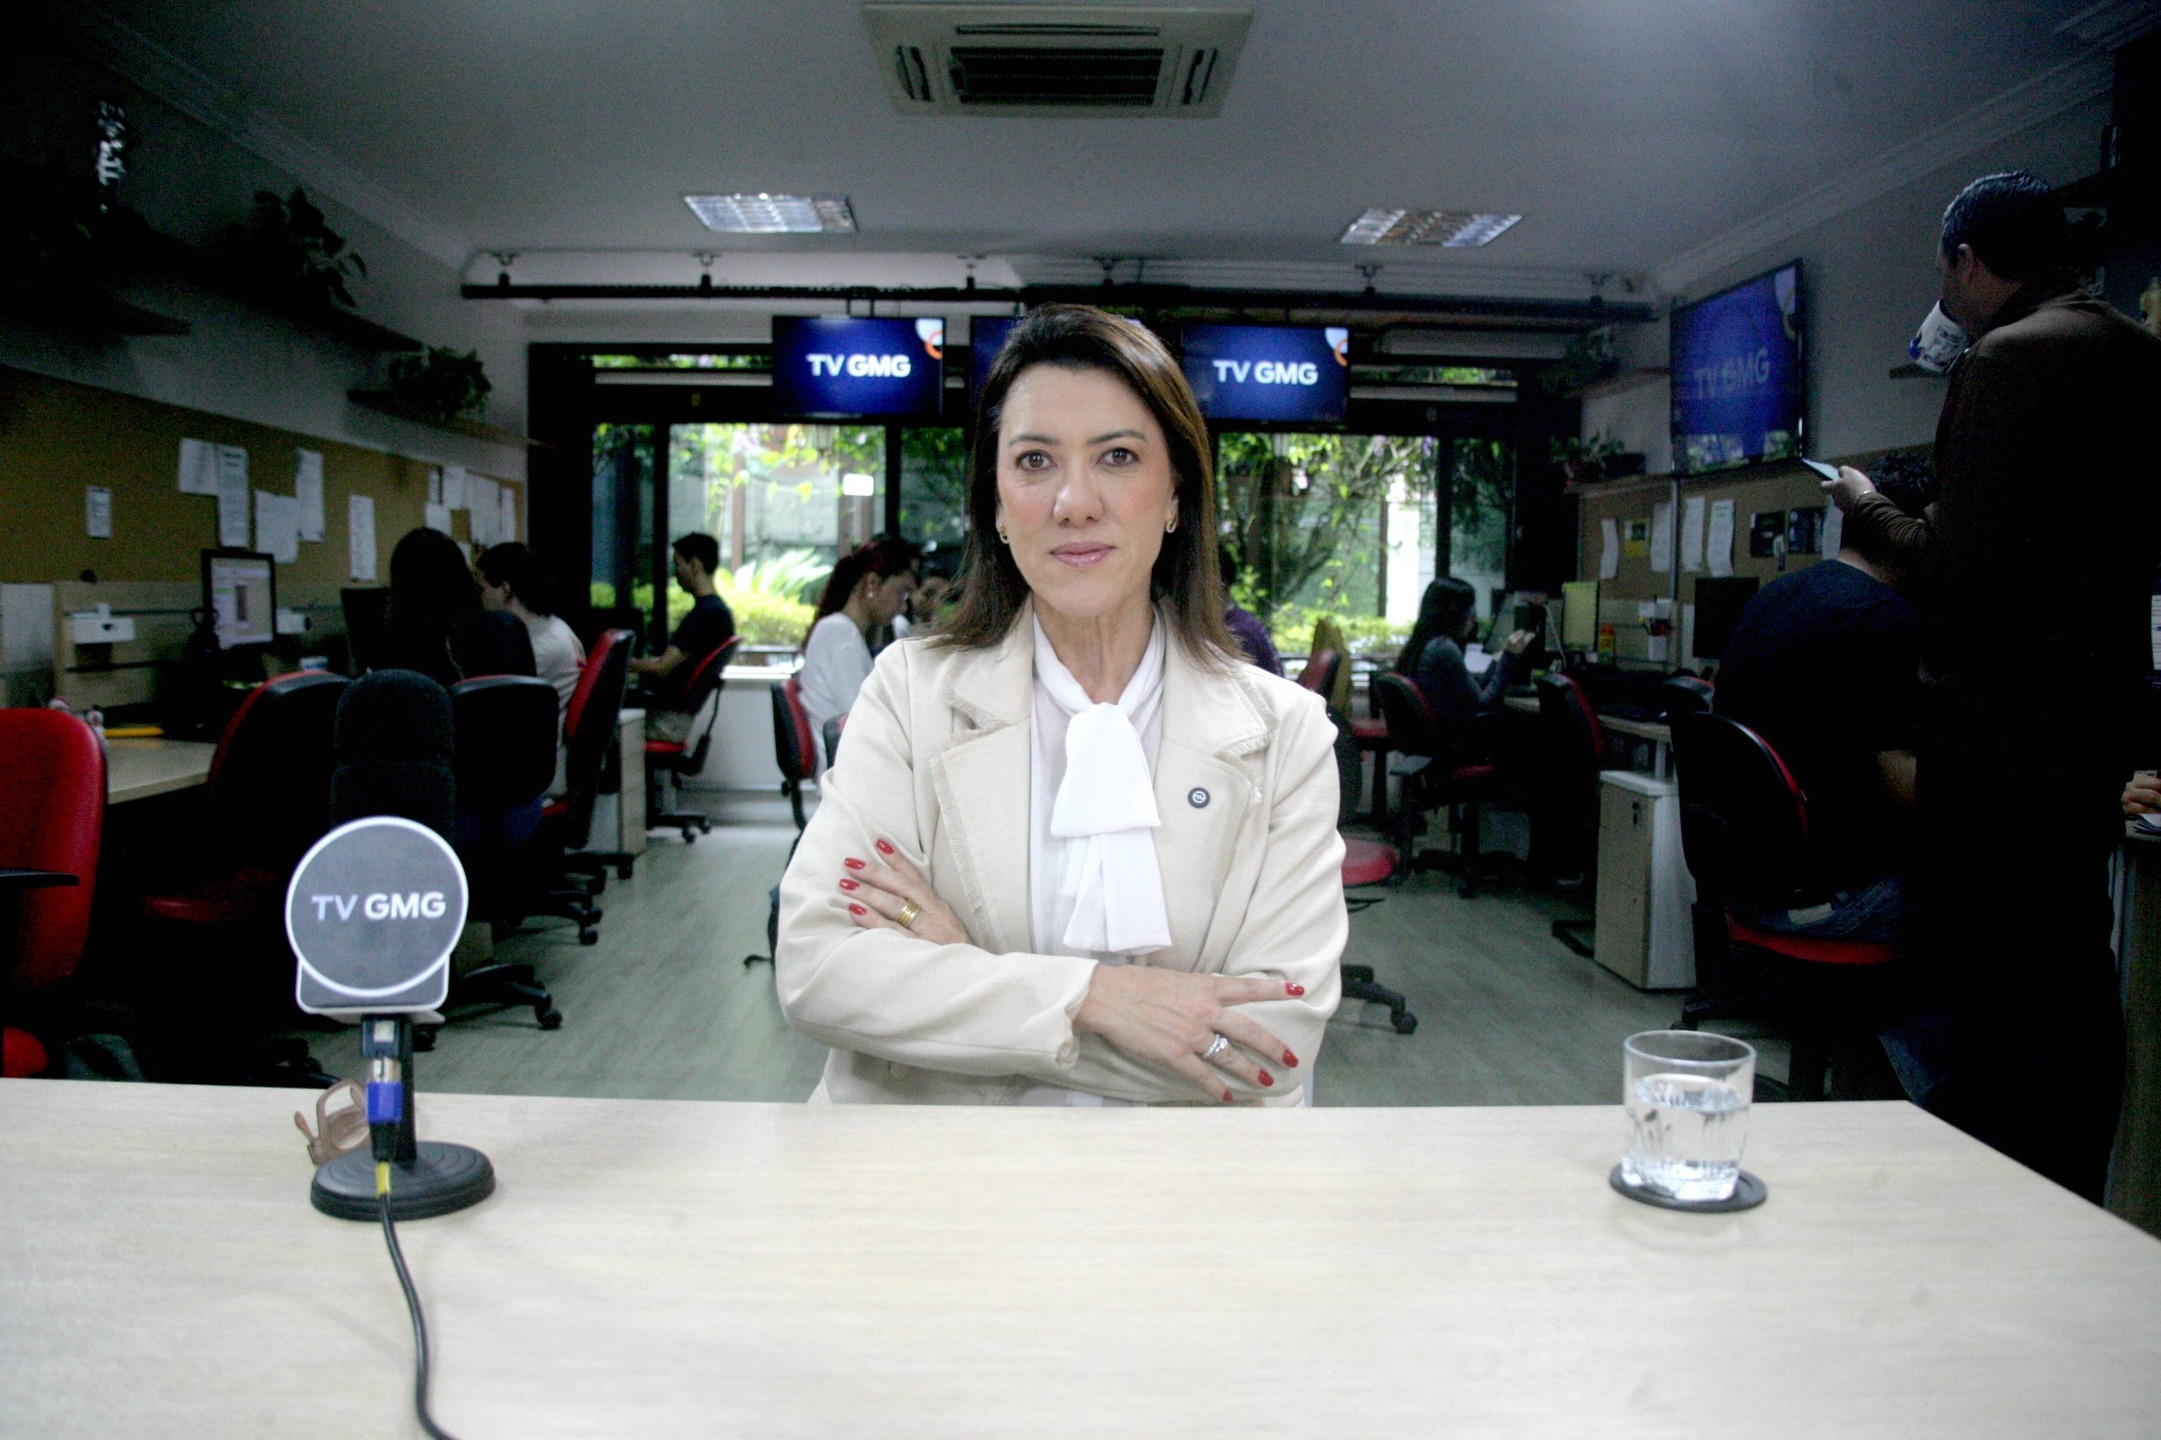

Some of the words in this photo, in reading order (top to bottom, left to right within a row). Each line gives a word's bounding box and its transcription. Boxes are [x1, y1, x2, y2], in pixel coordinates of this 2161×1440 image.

[806, 353, 845, 376] TV
[846, 354, 911, 377] GMG
[1213, 360, 1250, 382] TV
[1254, 361, 1318, 385] GMG
[311, 895, 358, 922] TV
[364, 892, 446, 920] GMG
